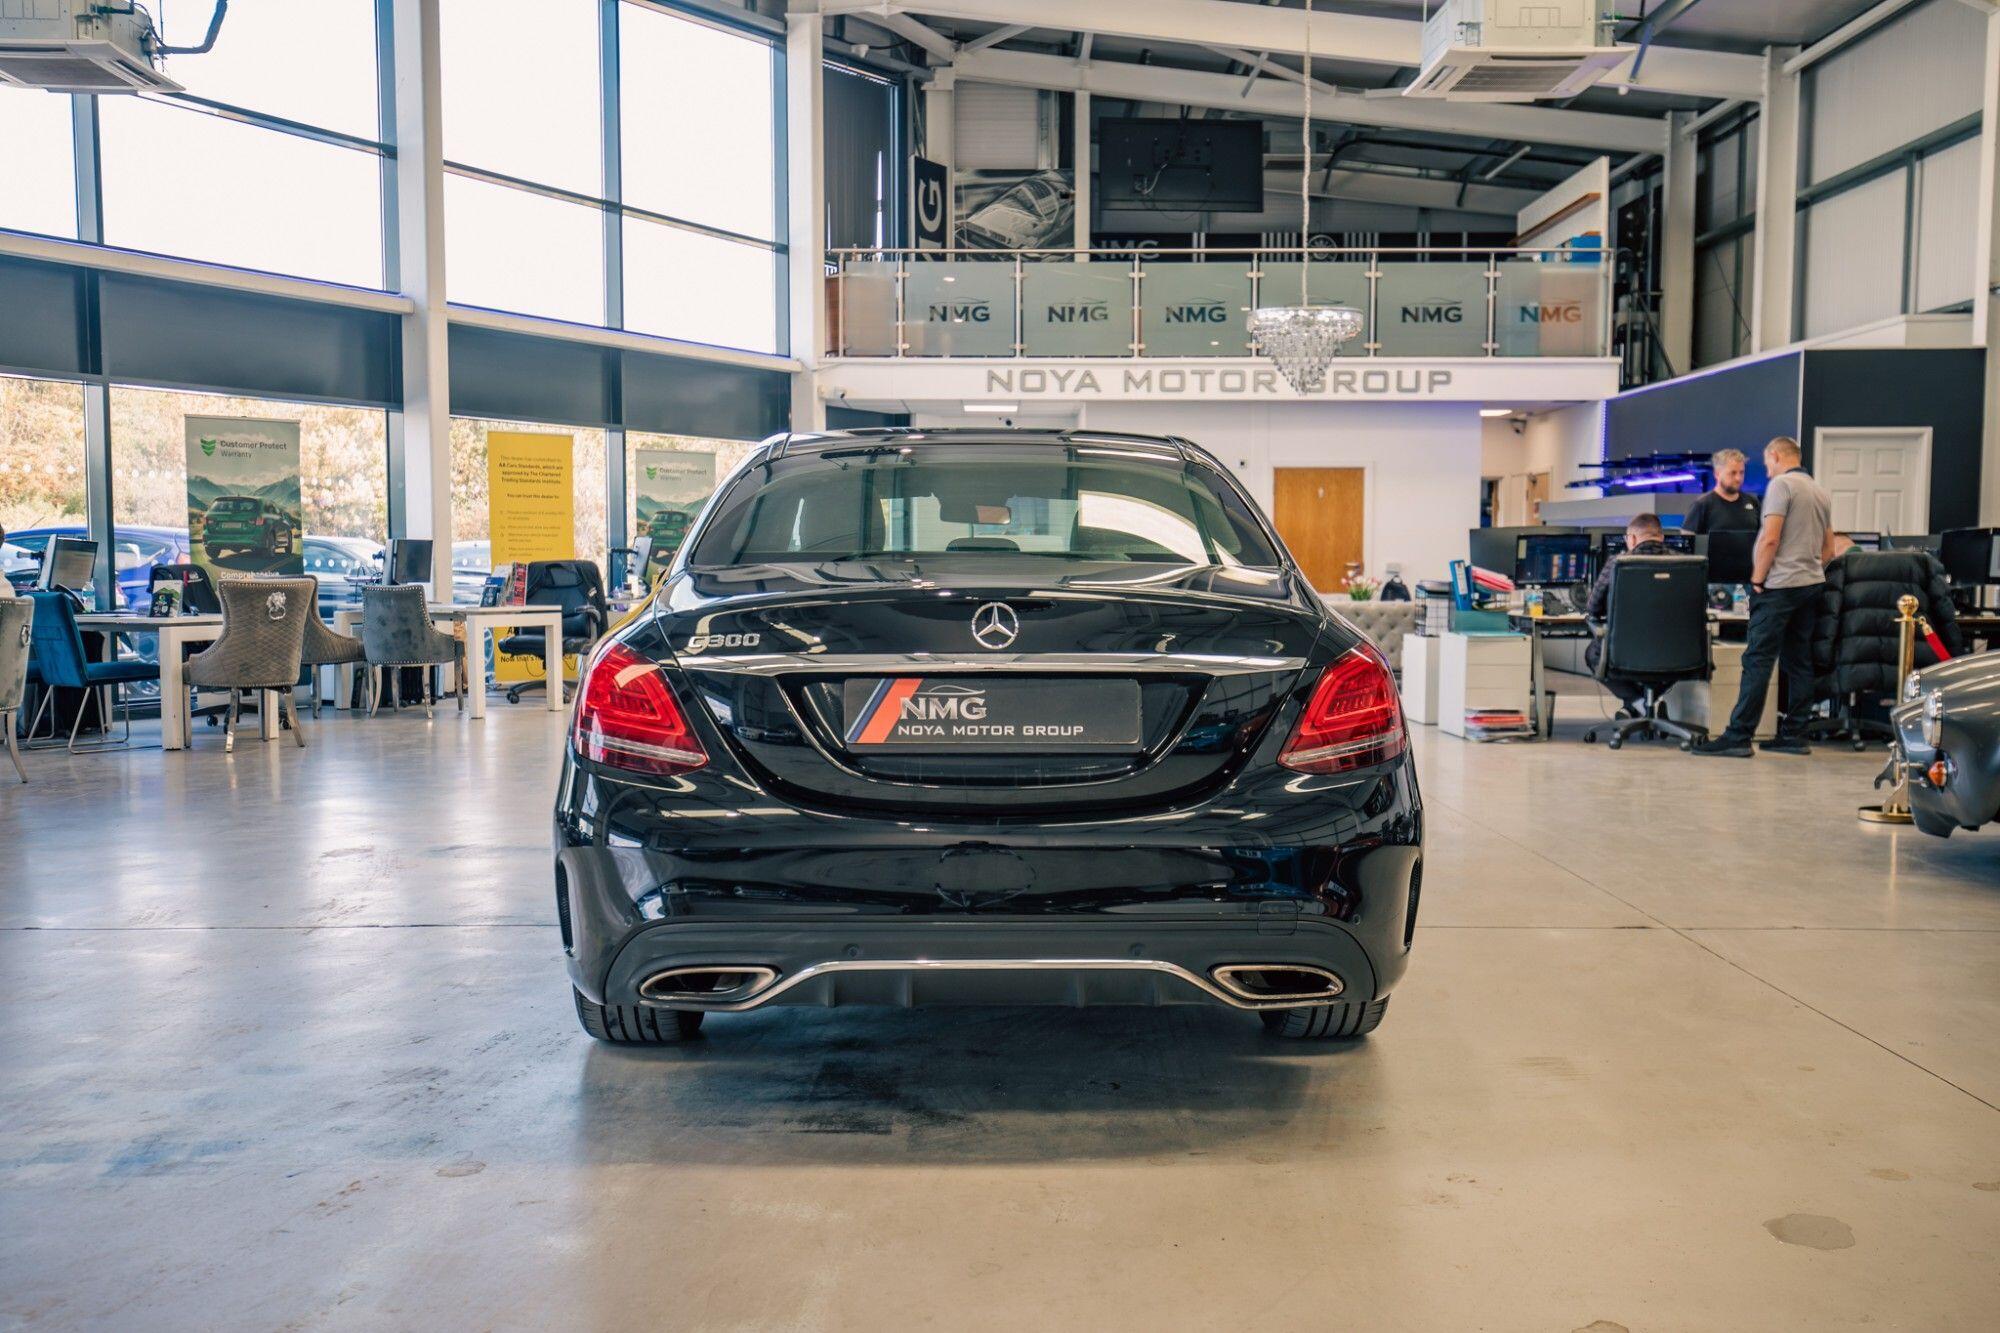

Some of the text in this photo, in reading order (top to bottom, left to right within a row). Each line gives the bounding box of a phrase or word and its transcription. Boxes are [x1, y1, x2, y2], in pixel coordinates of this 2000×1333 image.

[929, 305, 990, 322] NMG
[1048, 305, 1109, 323] NMG
[1165, 306, 1227, 323] NMG
[1401, 306, 1462, 323] NMG
[1520, 306, 1582, 323] NMG
[987, 369, 1102, 393] NOYA
[1123, 369, 1277, 393] MOTOR
[220, 440, 287, 450] Customer Protect
[220, 450, 252, 458] Warranty
[899, 696, 988, 720] NMG
[898, 725, 1084, 737] NOYA MOTOR GROUP
